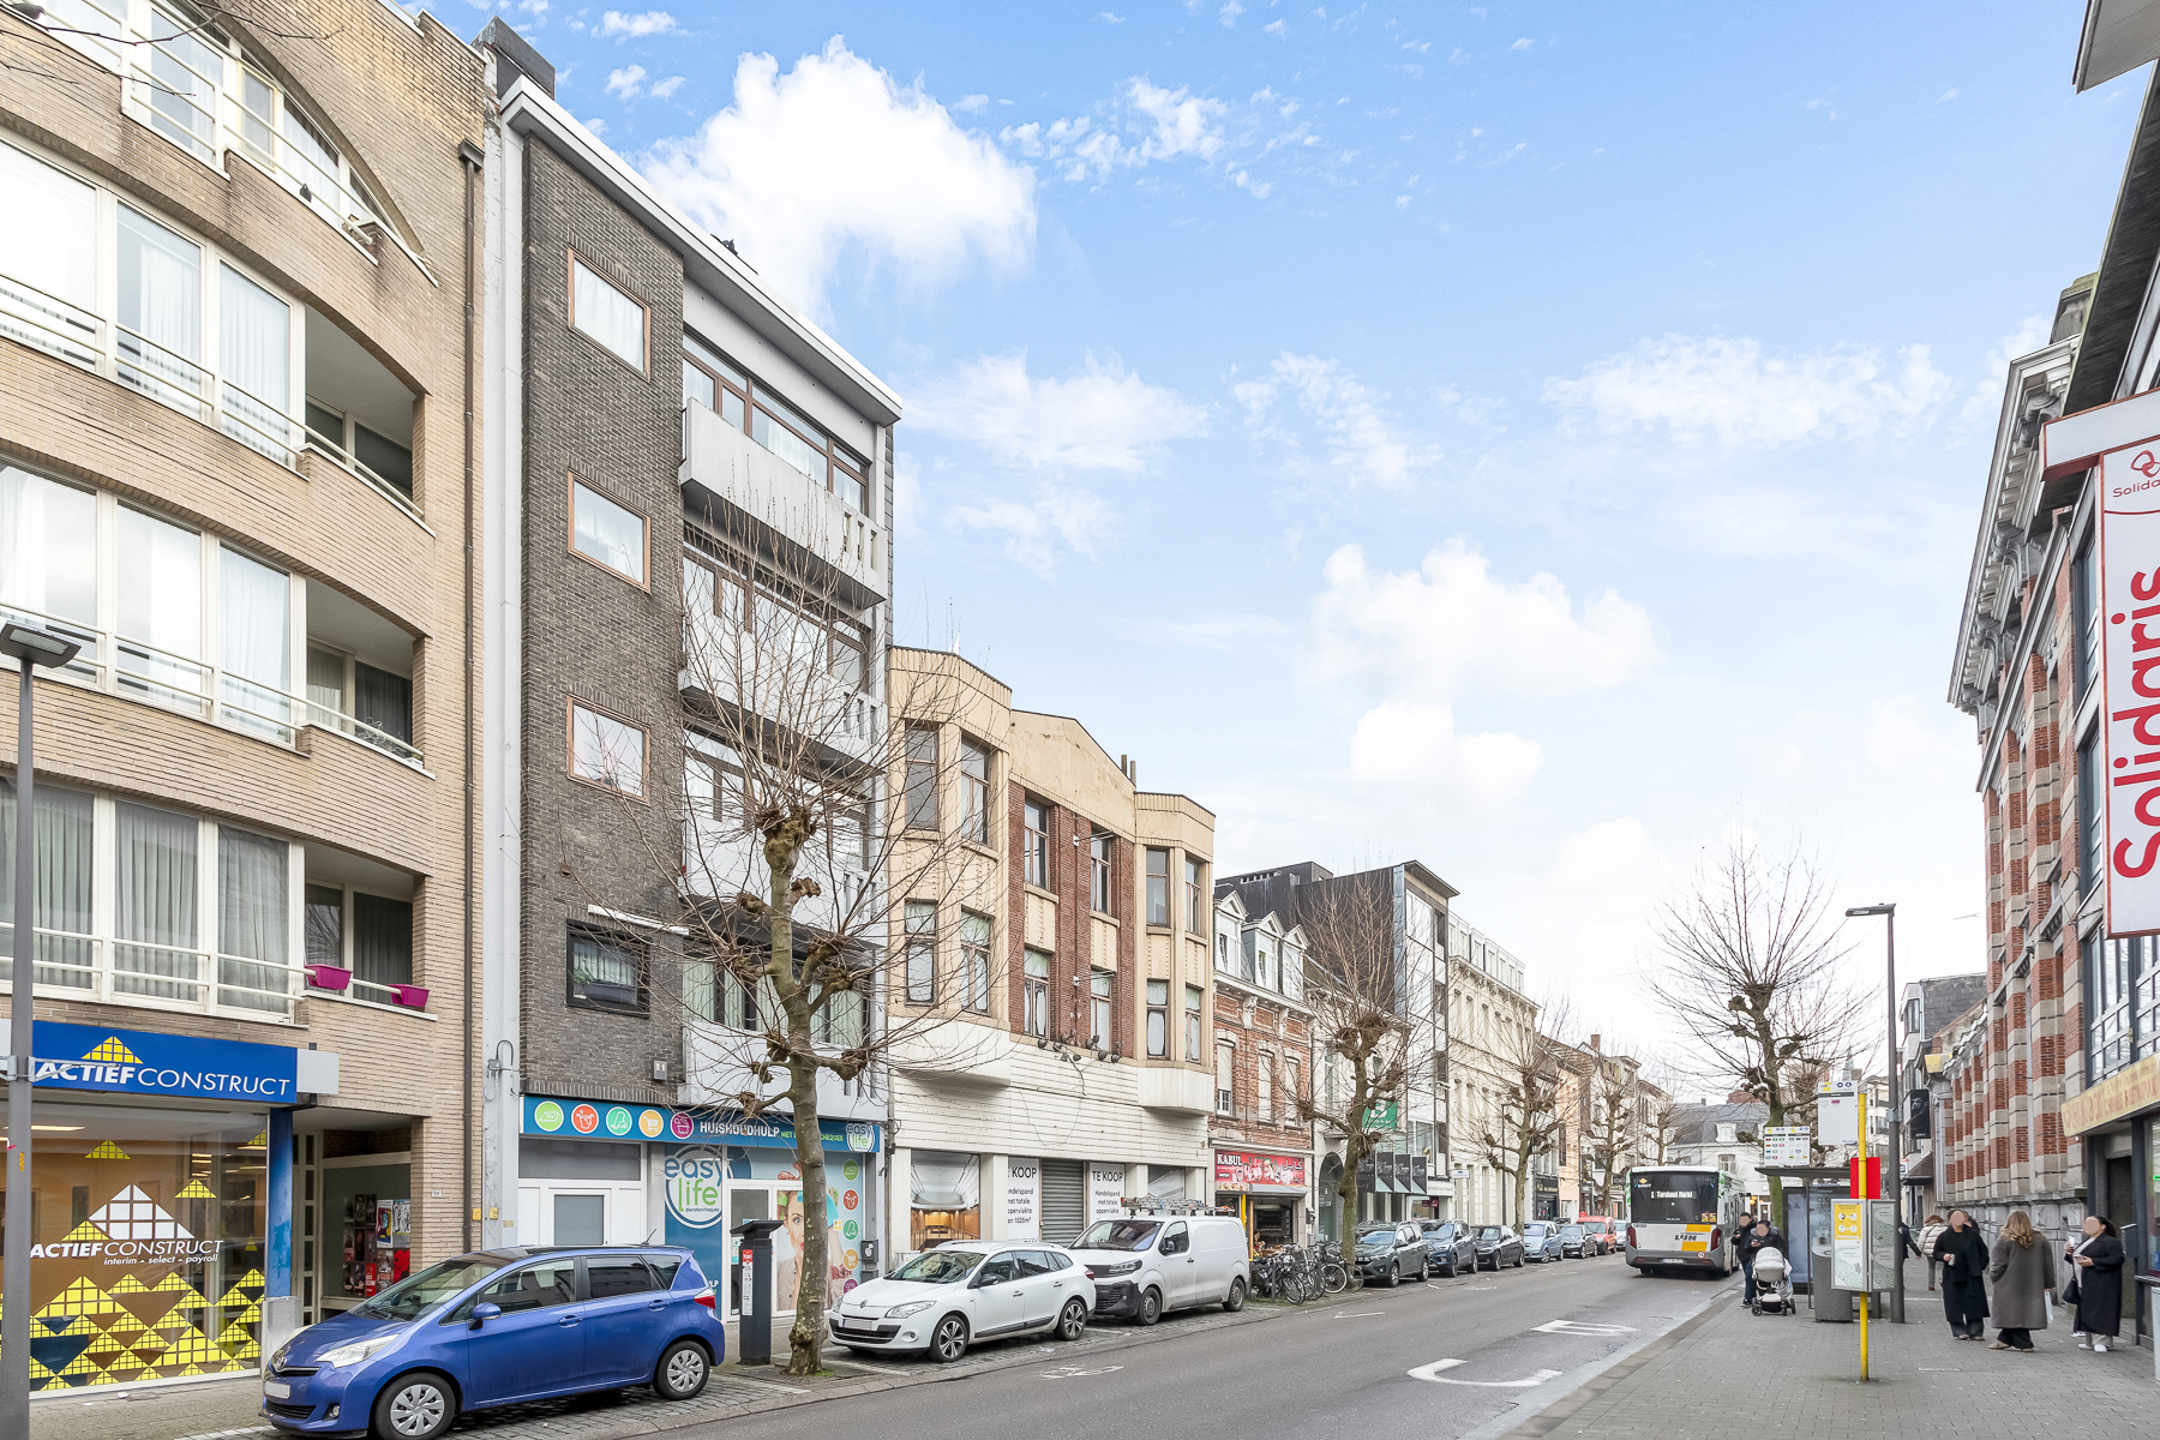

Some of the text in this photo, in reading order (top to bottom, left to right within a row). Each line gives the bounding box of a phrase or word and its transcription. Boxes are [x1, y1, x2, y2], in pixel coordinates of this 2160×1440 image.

[137, 1067, 290, 1096] CONSTRUCT
[699, 1121, 781, 1138] HUISHOUDHULP
[846, 1123, 873, 1138] easy
[851, 1133, 869, 1150] life
[1217, 1153, 1243, 1166] KABUL
[665, 1157, 722, 1188] easy
[1012, 1167, 1037, 1178] KOOP
[1092, 1171, 1123, 1182] TE KOOP
[678, 1178, 719, 1213] life
[29, 1240, 224, 1259] ACTIEF CONSTRUCT
[103, 1253, 218, 1266] interim select payroll
